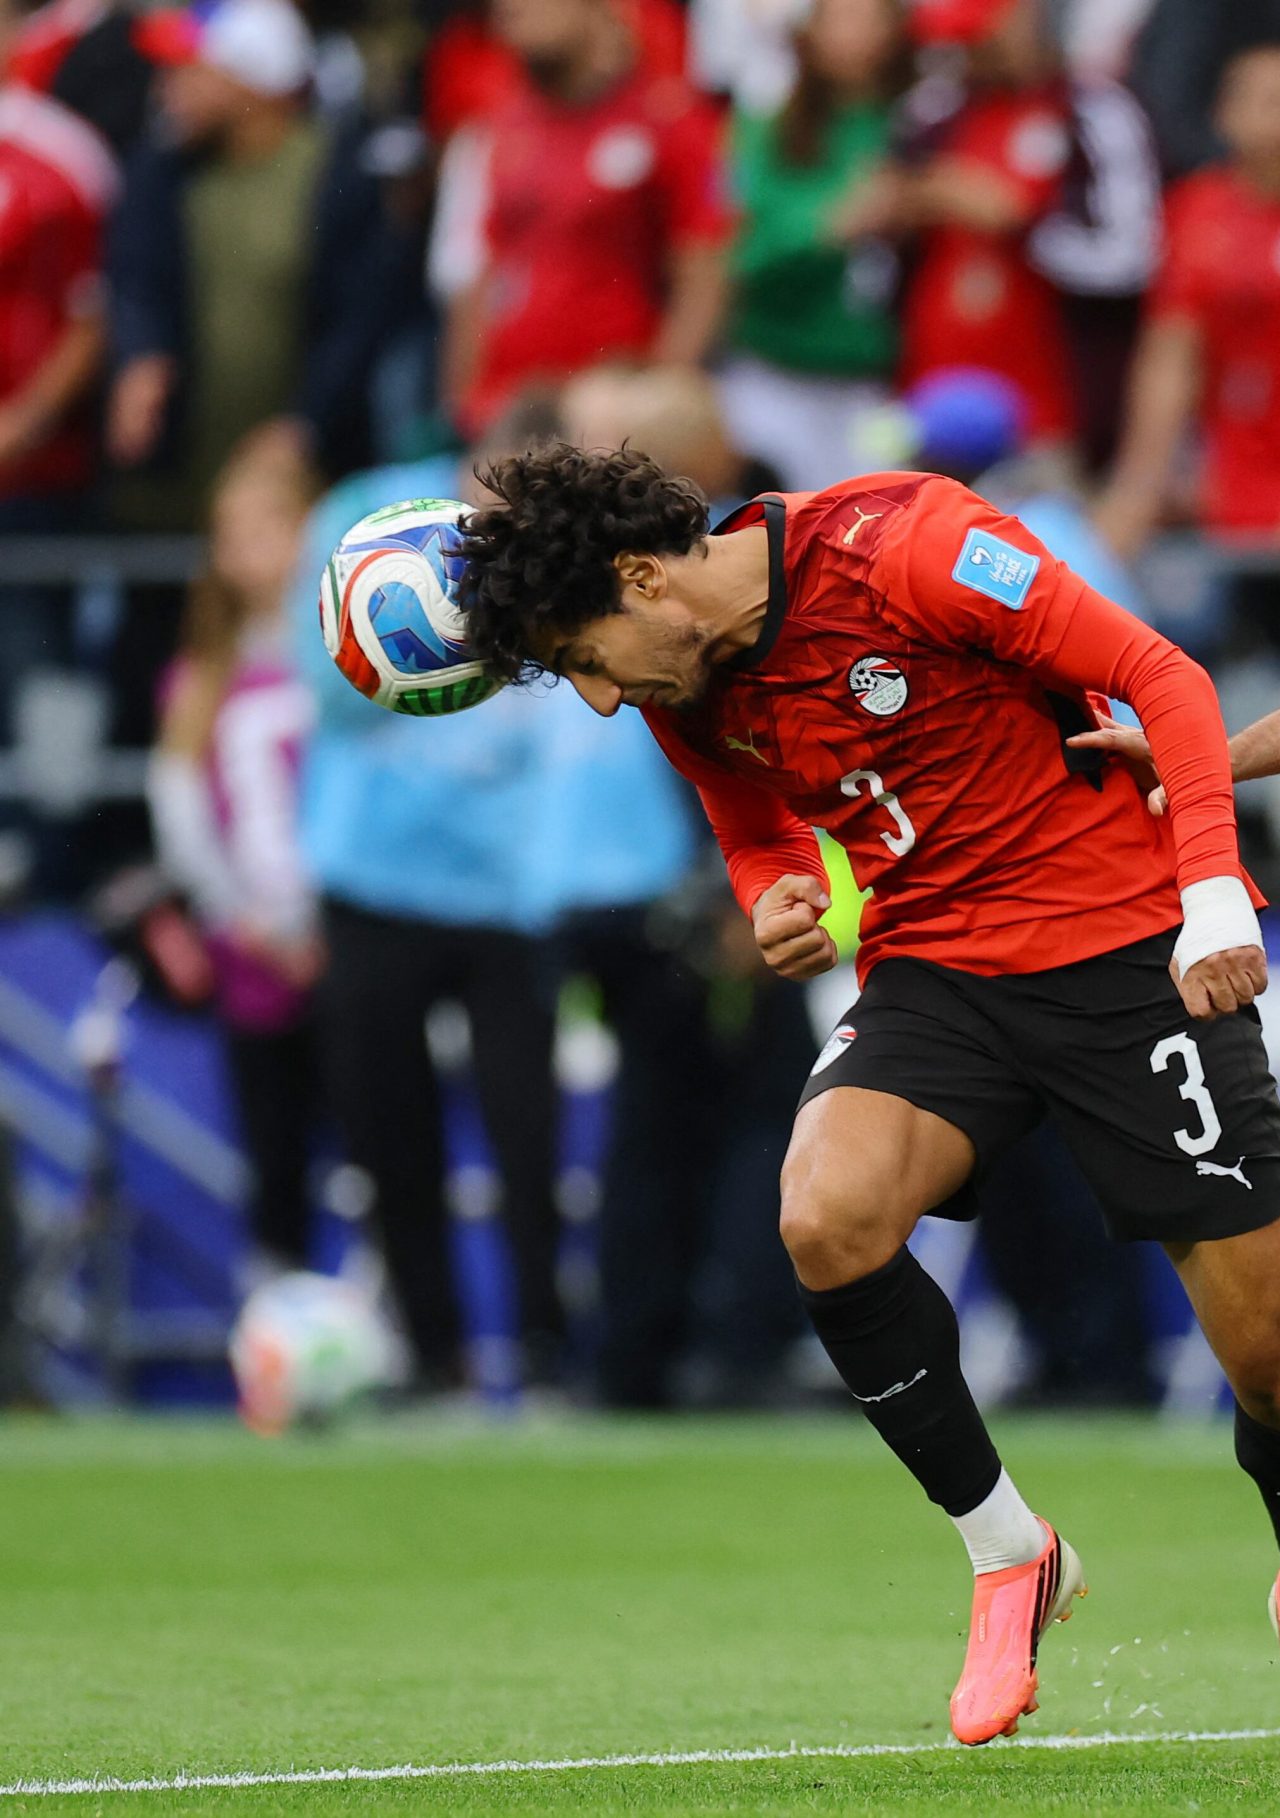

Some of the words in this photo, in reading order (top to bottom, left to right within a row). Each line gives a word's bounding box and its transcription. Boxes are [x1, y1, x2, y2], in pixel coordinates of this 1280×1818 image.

[1001, 558, 1022, 587] PEACE
[840, 768, 916, 857] 3
[1150, 1031, 1222, 1157] 3
